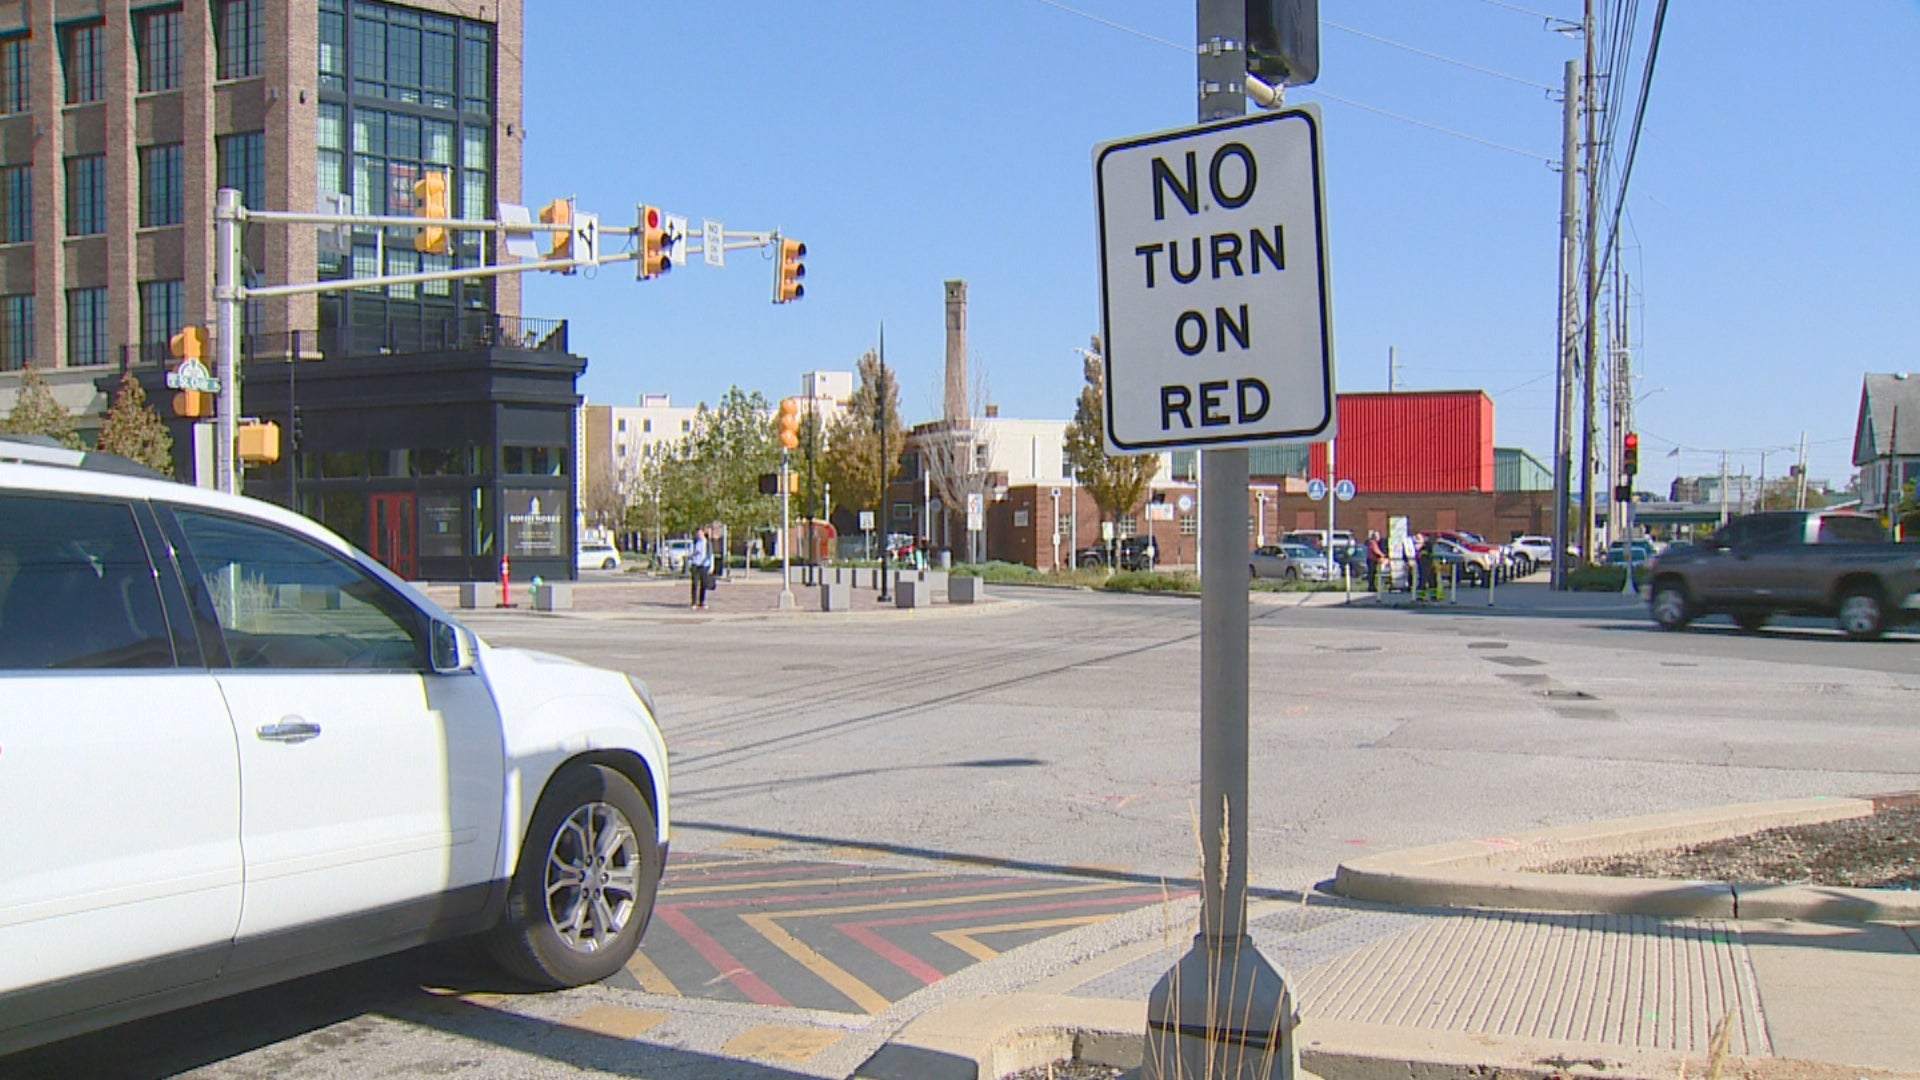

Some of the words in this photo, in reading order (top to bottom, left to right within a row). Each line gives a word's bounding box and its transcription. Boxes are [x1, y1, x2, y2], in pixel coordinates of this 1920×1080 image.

[1151, 142, 1257, 221] NO
[1135, 225, 1286, 288] TURN
[1174, 303, 1250, 356] ON
[1161, 377, 1270, 430] RED
